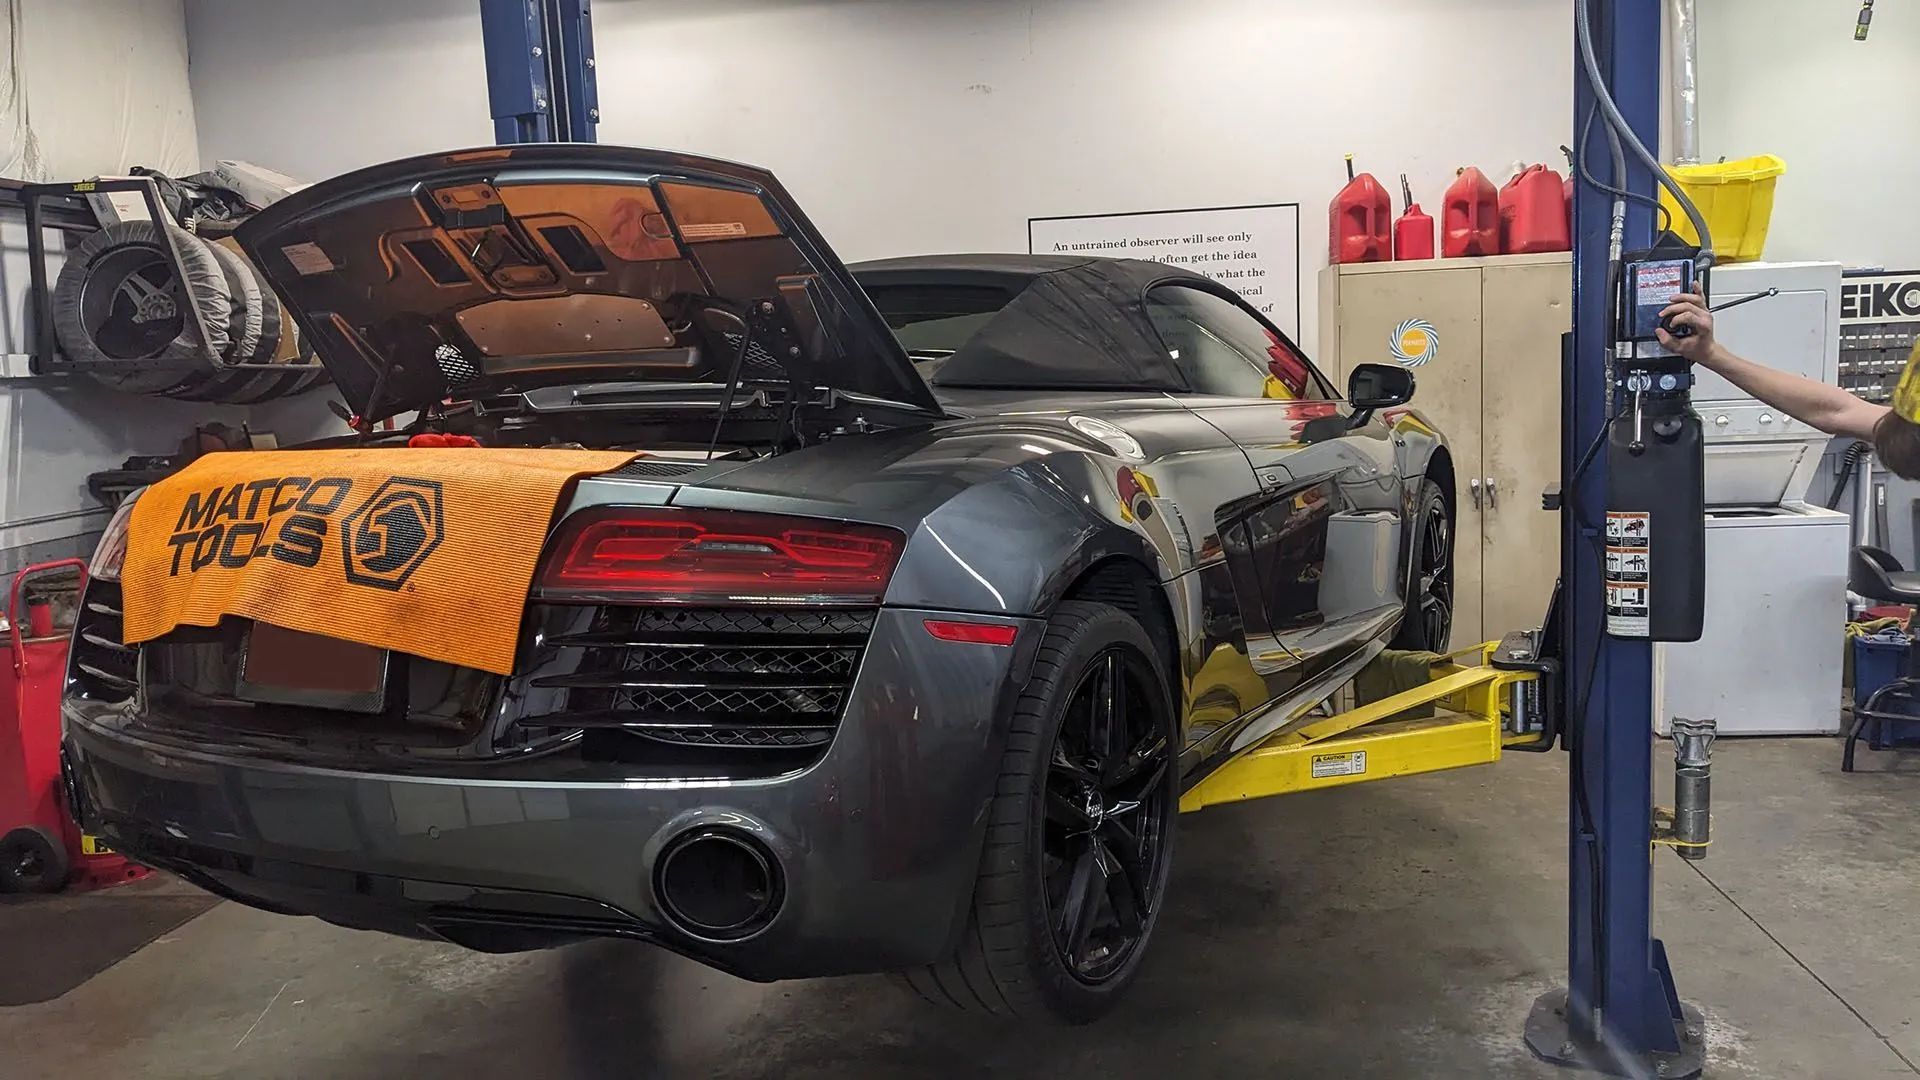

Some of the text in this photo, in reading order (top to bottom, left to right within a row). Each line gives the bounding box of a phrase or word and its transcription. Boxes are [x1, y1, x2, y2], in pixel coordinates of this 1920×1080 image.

[73, 182, 96, 192] JEGS
[1053, 231, 1252, 251] An untrained observer will see only
[1159, 254, 1188, 264] often
[1191, 253, 1208, 264] get
[1212, 251, 1230, 261] the
[1233, 250, 1257, 260] idea
[1216, 269, 1244, 278] what
[1247, 268, 1265, 277] the
[1236, 286, 1263, 295] sical
[1261, 303, 1274, 312] of
[174, 476, 354, 532] MATCO
[167, 514, 328, 577] TOOLS
